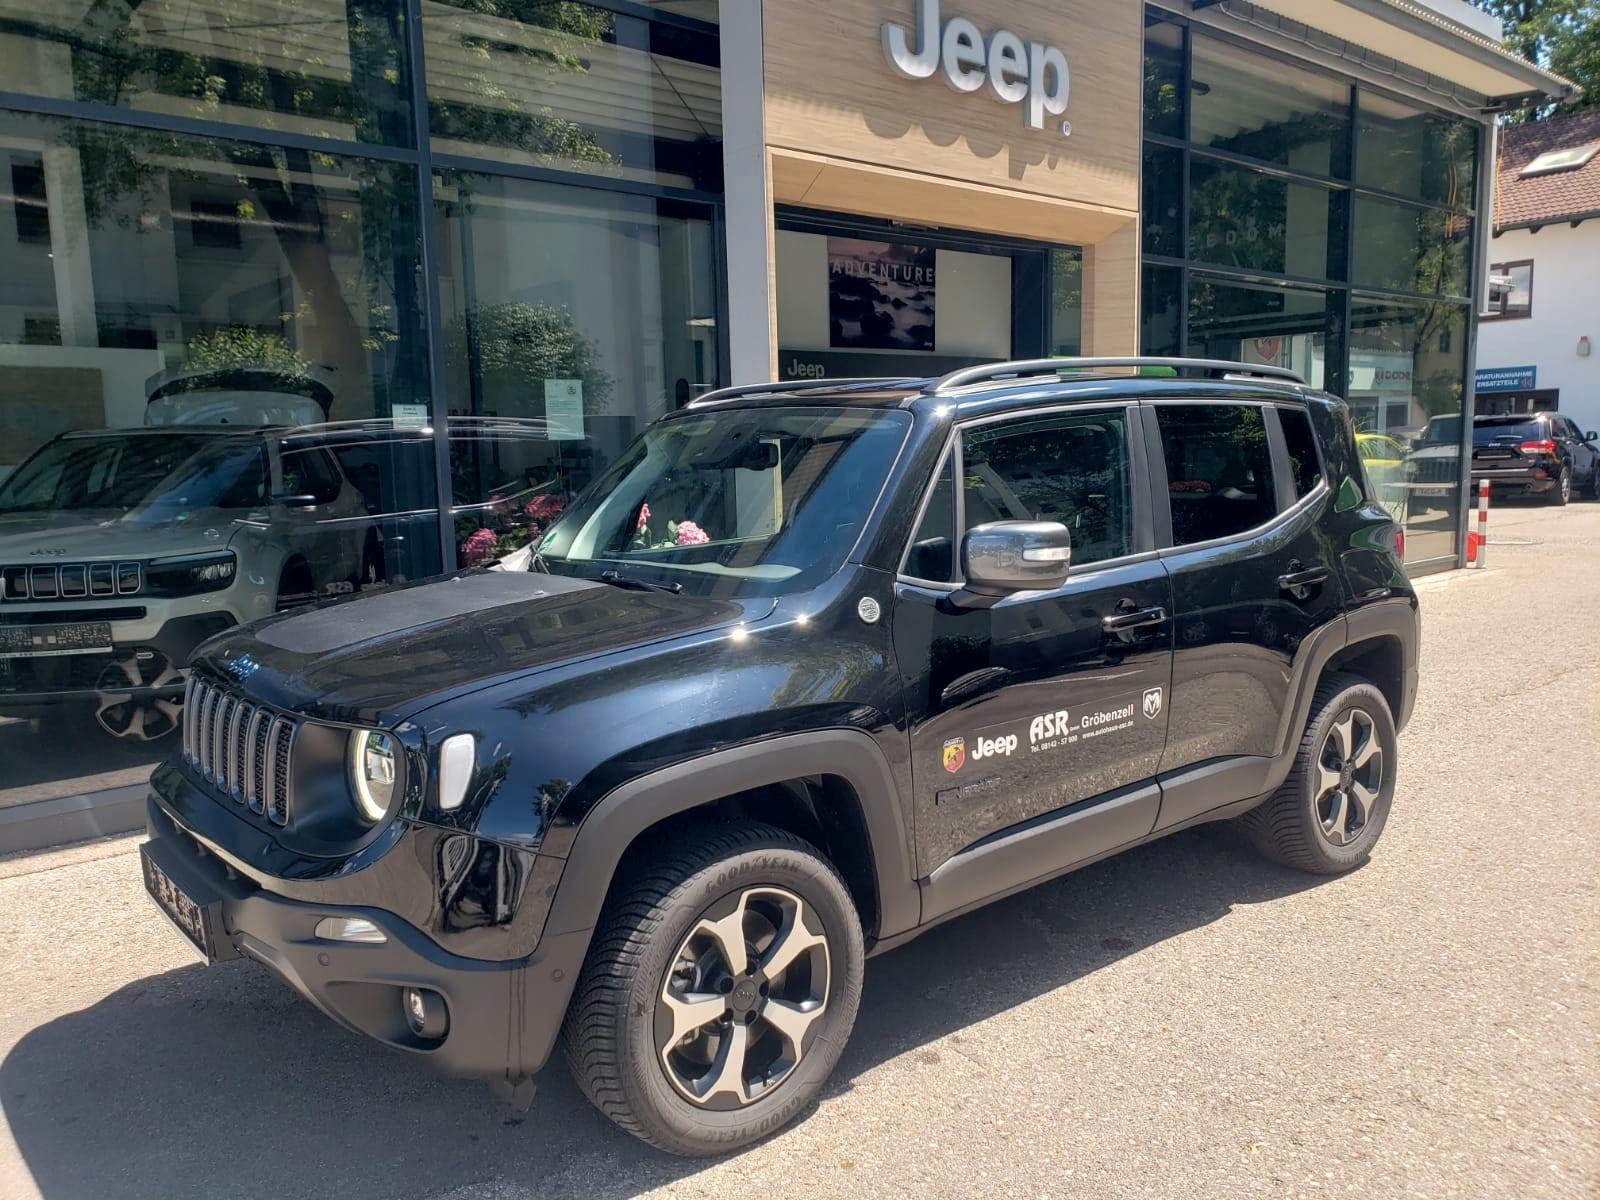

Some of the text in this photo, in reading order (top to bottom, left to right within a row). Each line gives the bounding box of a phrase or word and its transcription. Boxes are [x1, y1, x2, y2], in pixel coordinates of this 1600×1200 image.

[881, 0, 1070, 130] Jeep
[832, 260, 933, 282] ADVENTURE
[787, 358, 825, 378] Jeep
[1029, 710, 1069, 744] ASR
[1081, 704, 1134, 729] Gröbenzell
[972, 734, 1018, 760] Jeep
[1030, 745, 1041, 753] Tel.
